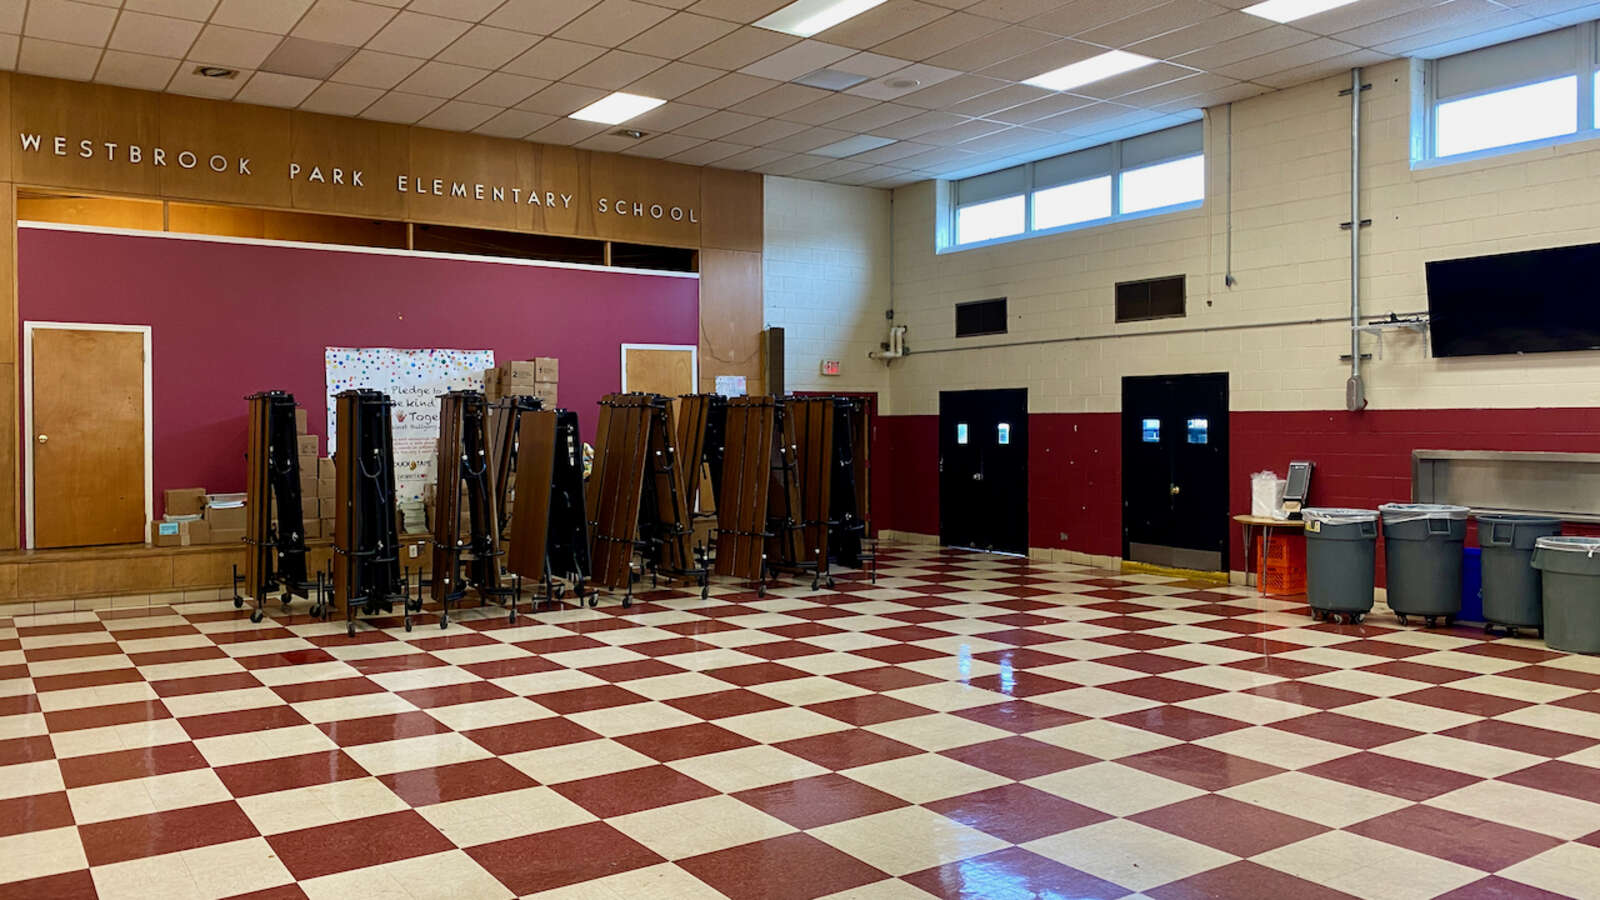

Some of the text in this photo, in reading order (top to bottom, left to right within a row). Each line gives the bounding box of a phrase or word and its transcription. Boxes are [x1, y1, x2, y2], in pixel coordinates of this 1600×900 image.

[20, 133, 698, 222] WESTBROOK PARK ELEMENTARY SCHOOL
[391, 385, 430, 397] Pledge
